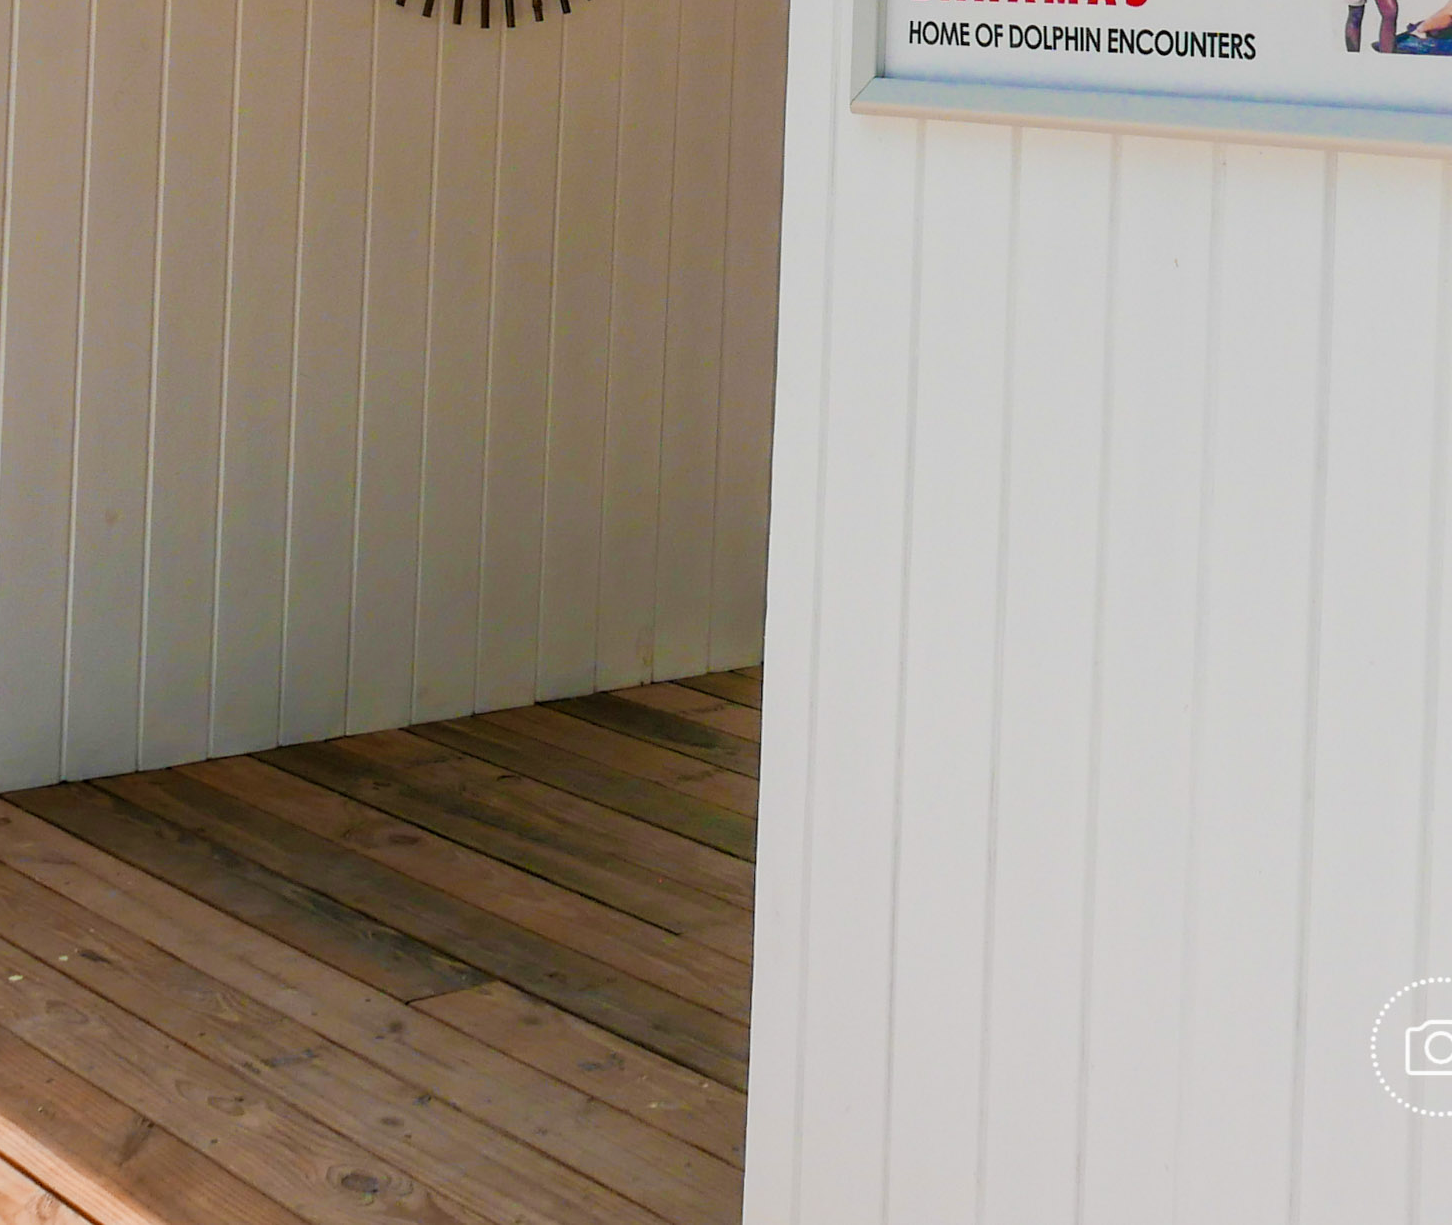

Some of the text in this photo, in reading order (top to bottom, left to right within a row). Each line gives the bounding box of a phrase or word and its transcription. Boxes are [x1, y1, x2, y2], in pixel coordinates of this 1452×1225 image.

[910, 21, 1256, 60] HOME OF DOLPHIN ENCOUNTERS
